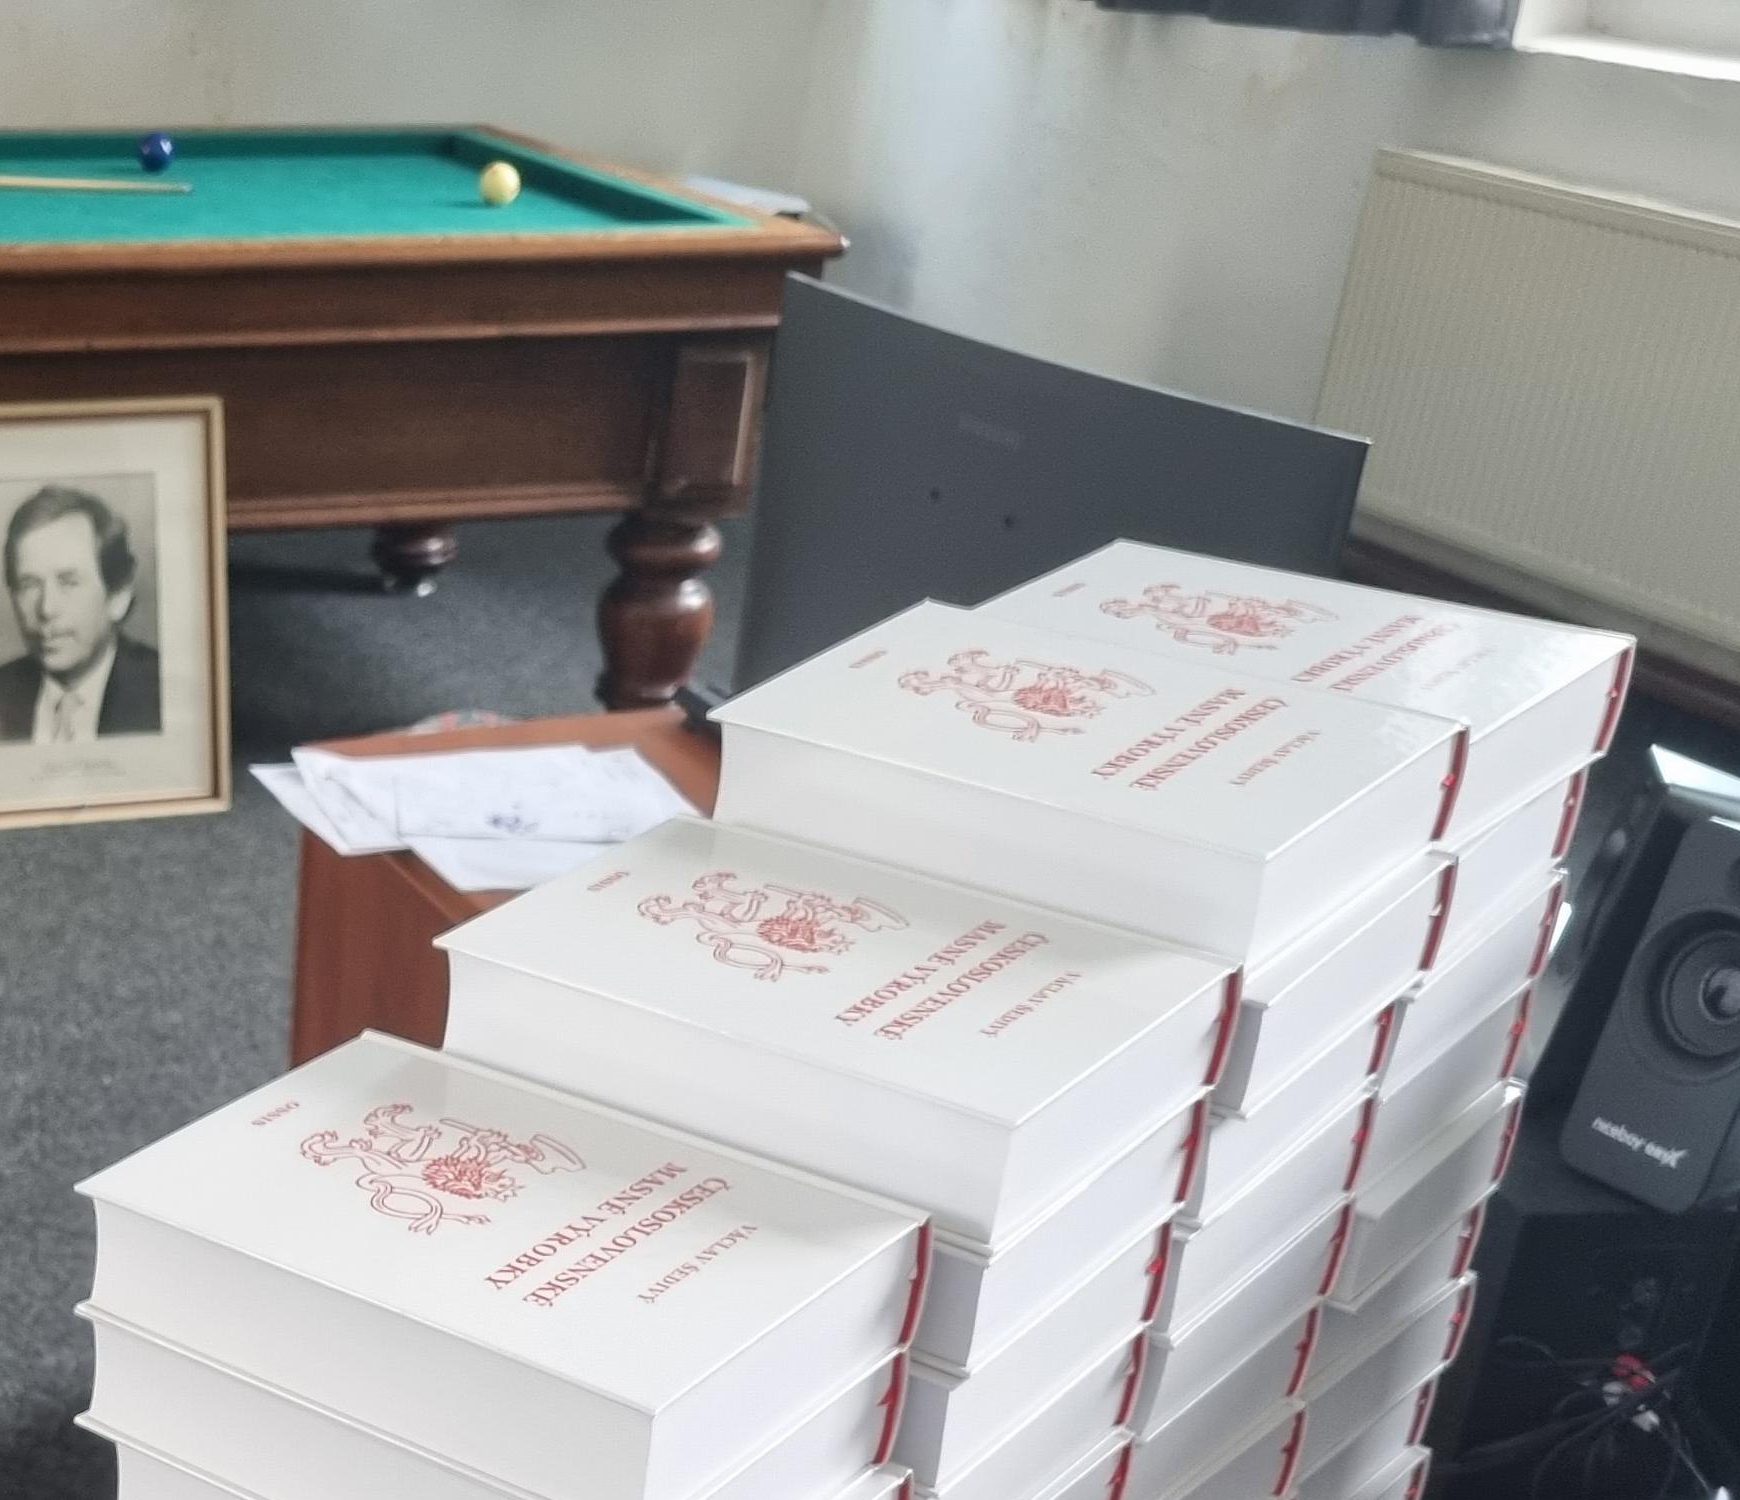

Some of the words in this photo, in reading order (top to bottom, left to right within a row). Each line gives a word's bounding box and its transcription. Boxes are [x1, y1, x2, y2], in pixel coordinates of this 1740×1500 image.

[928, 919, 1008, 967] MASNÉ
[834, 964, 937, 1026] VÝROBKY
[873, 931, 1050, 1040] ČESKOSLOVENSKÉ
[597, 1161, 688, 1216] MASNÉ
[484, 1214, 606, 1290] VÝROBKY
[522, 1176, 733, 1308] ČESKOSLOVENSKÉ
[695, 1223, 758, 1265] VÁCLAV
[637, 1262, 700, 1304] ŠEDIVÝ
